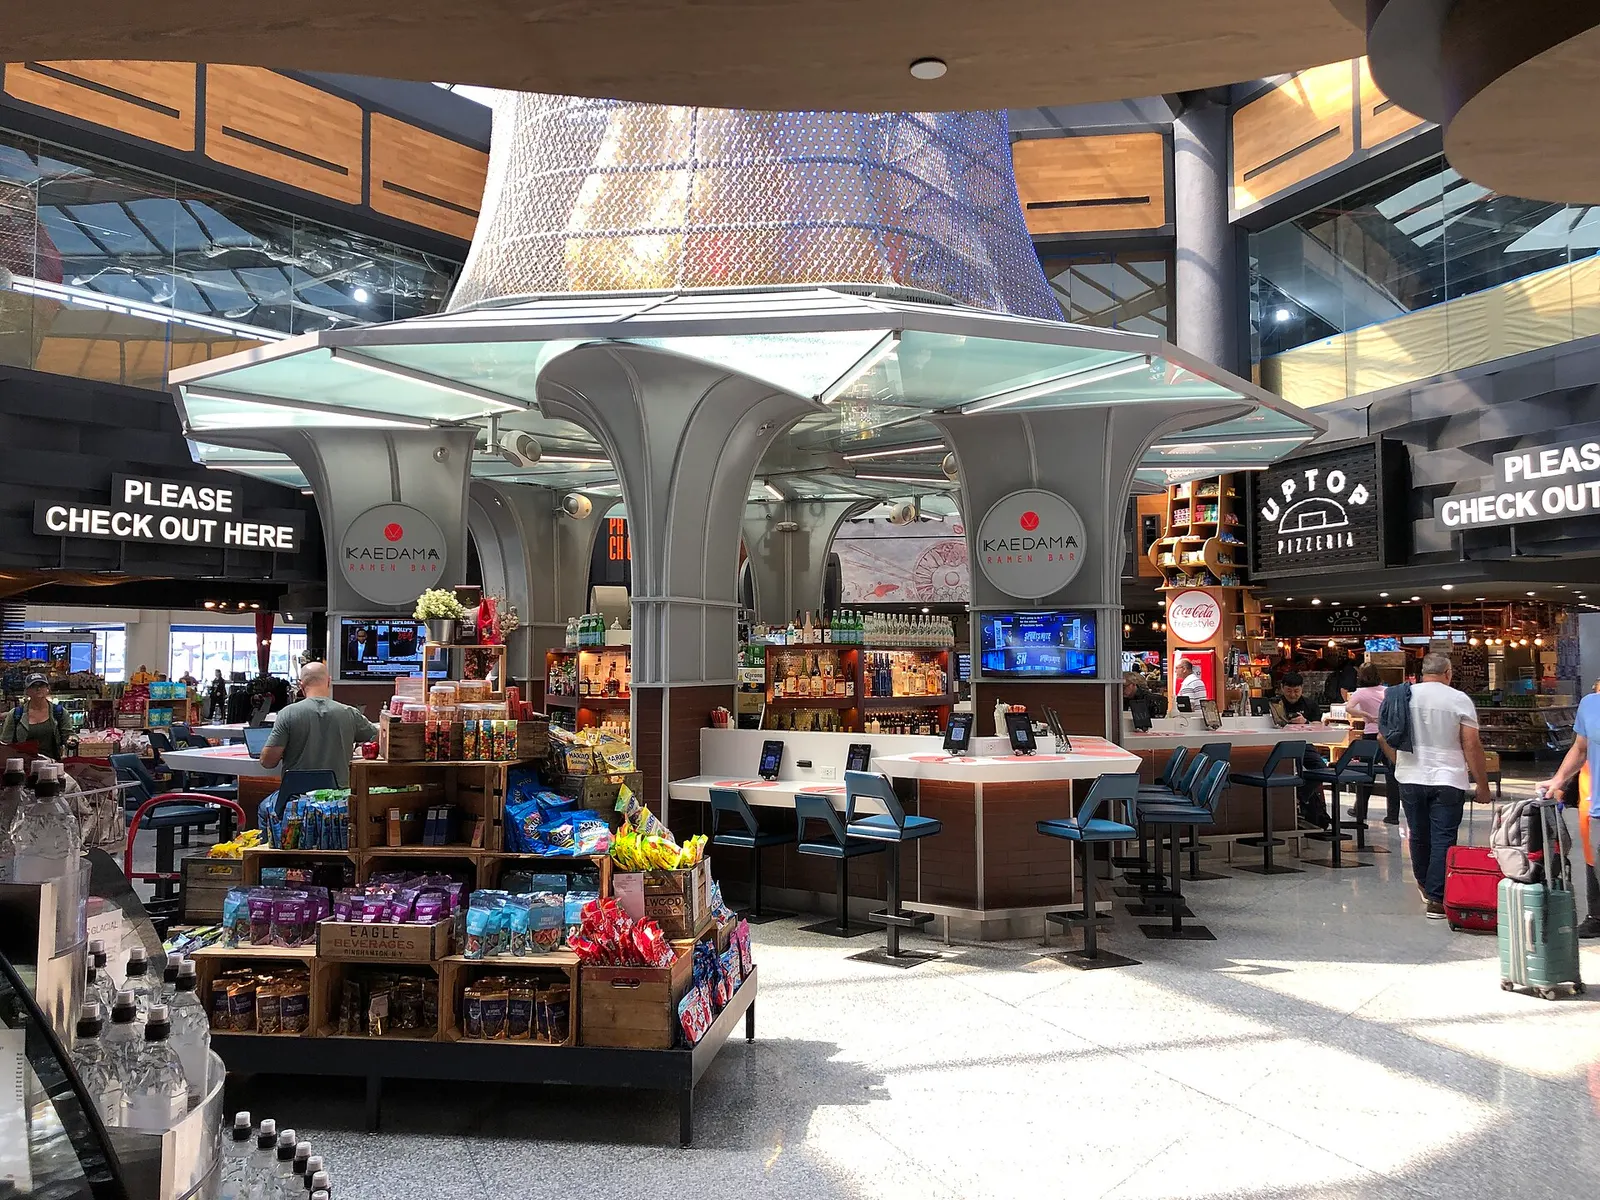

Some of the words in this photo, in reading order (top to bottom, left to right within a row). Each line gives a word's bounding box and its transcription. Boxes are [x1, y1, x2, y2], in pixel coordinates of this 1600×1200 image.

[124, 479, 233, 512] PLEASE
[1261, 468, 1369, 522] UPTOP
[1441, 489, 1538, 527] CHECK
[1541, 481, 1600, 515] OUT
[45, 505, 154, 539] CHECK
[158, 516, 217, 543] OUT
[224, 521, 294, 549] HERE
[983, 535, 1079, 552] KAEDAMA
[1277, 531, 1354, 555] PIZZERIA
[345, 547, 440, 560] KAEDAMA
[987, 554, 1033, 564] RAMEN
[1048, 552, 1075, 562] BAR
[349, 563, 397, 572] RAMEN
[410, 564, 437, 572] BAR
[1327, 609, 1368, 624] UPTOP
[1174, 619, 1215, 629] freestyle
[753, 656, 765, 665] He
[645, 897, 682, 907] LWOOD
[350, 925, 400, 938] EAGLE
[333, 938, 414, 950] BEVERAGES
